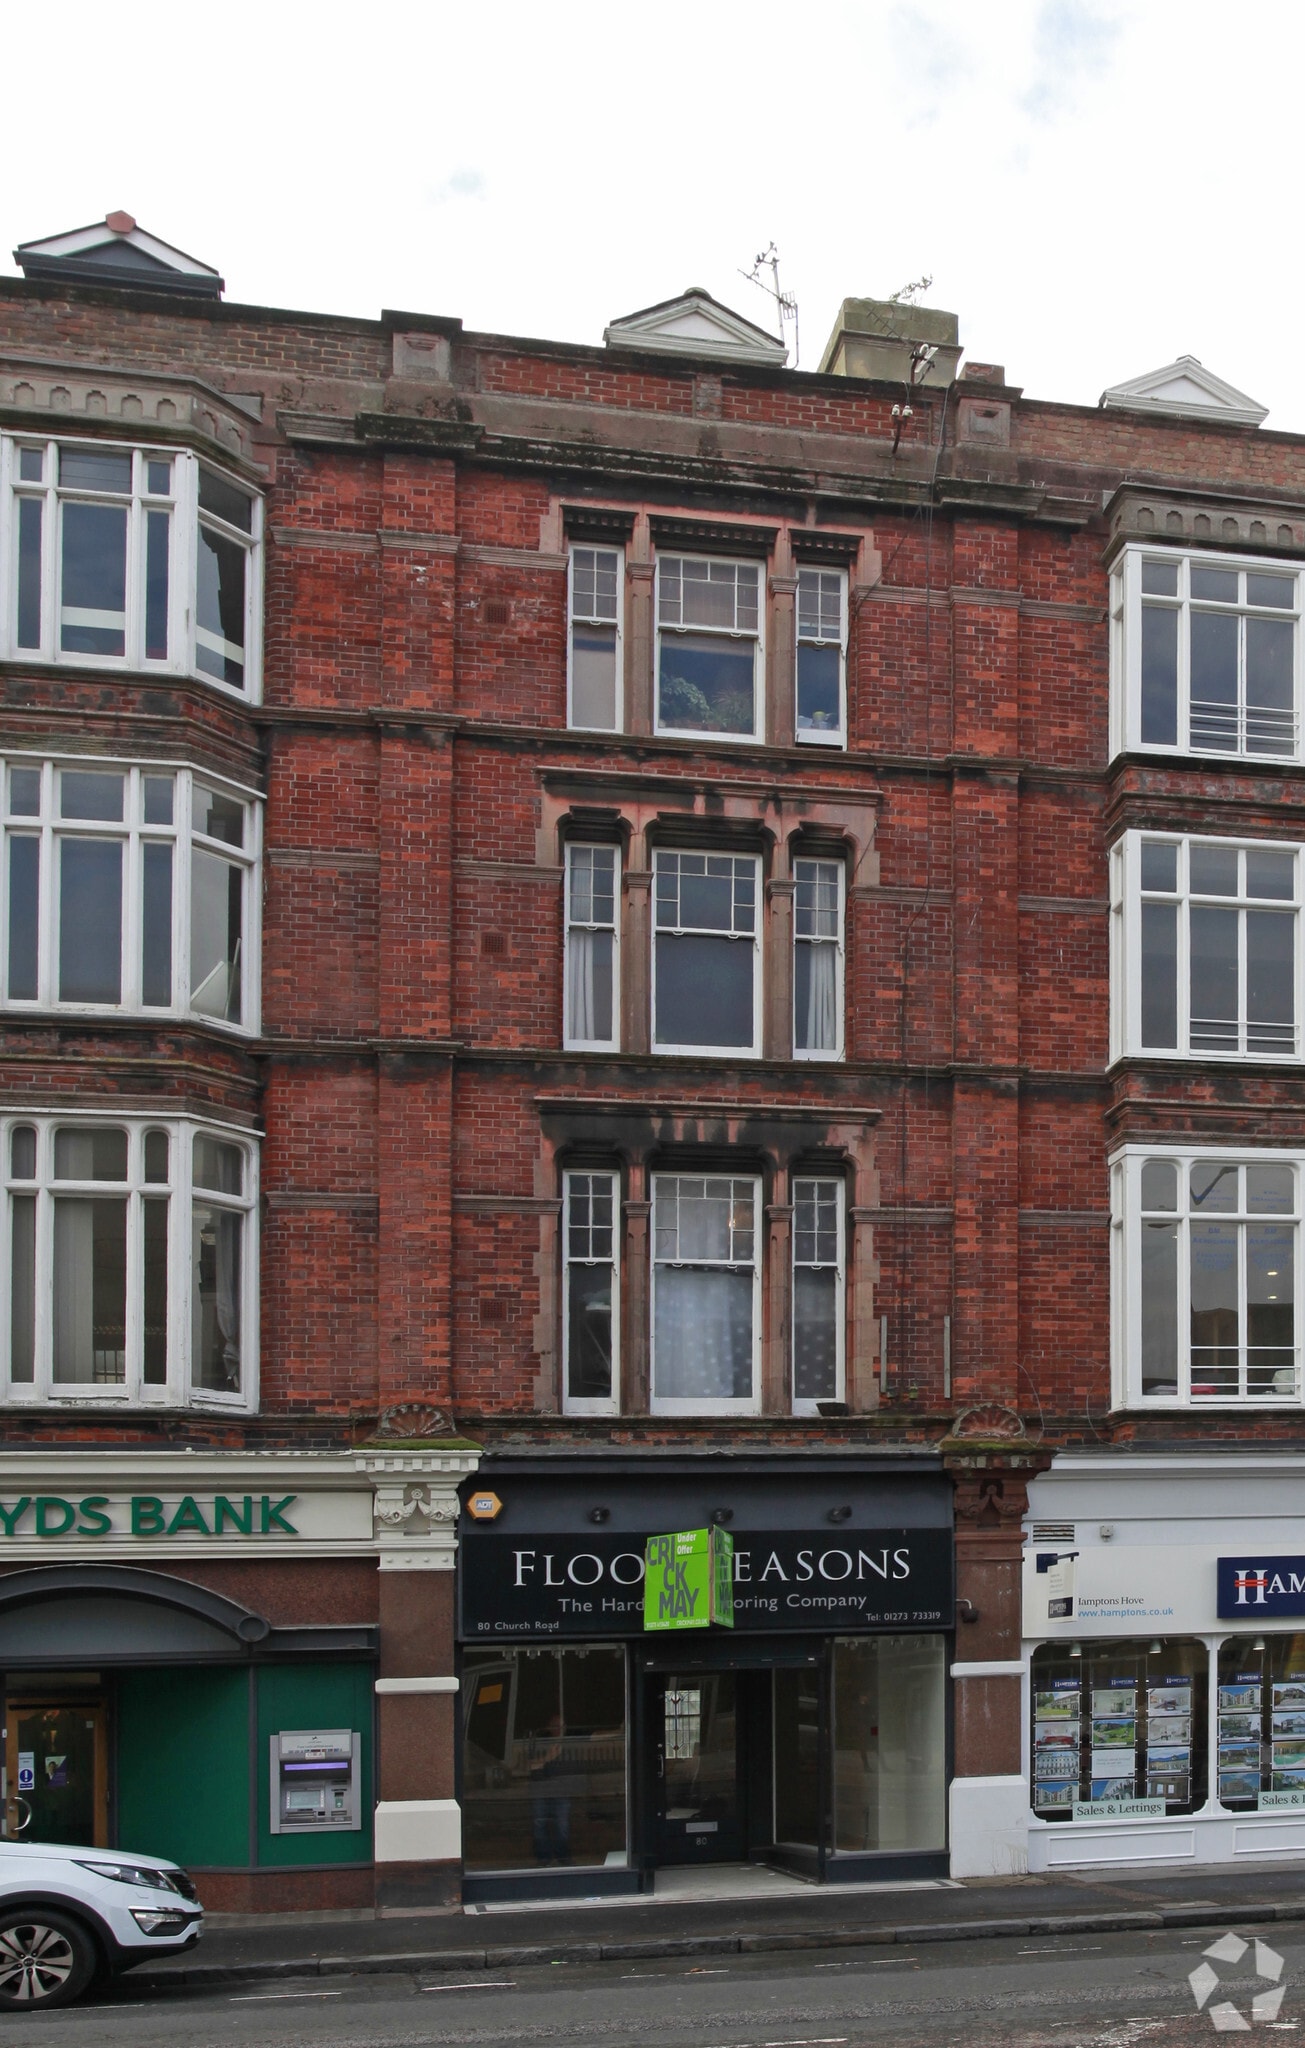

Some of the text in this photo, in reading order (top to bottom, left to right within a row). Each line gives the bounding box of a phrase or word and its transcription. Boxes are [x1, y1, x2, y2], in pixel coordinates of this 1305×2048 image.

[476, 1500, 493, 1509] ADT
[131, 1495, 299, 1535] BANK
[677, 1533, 697, 1542] Under
[677, 1545, 693, 1555] Offer
[512, 1548, 911, 1586] FLOO EASONS
[557, 1594, 867, 1612] The Hard oring Company
[866, 1611, 941, 1621] Tel: 01273 733319
[477, 1621, 559, 1630] 80 Church Road
[1261, 1794, 1289, 1806] Sales
[1290, 1794, 1300, 1804] &
[1076, 1802, 1162, 1816] Sales & Lettings
